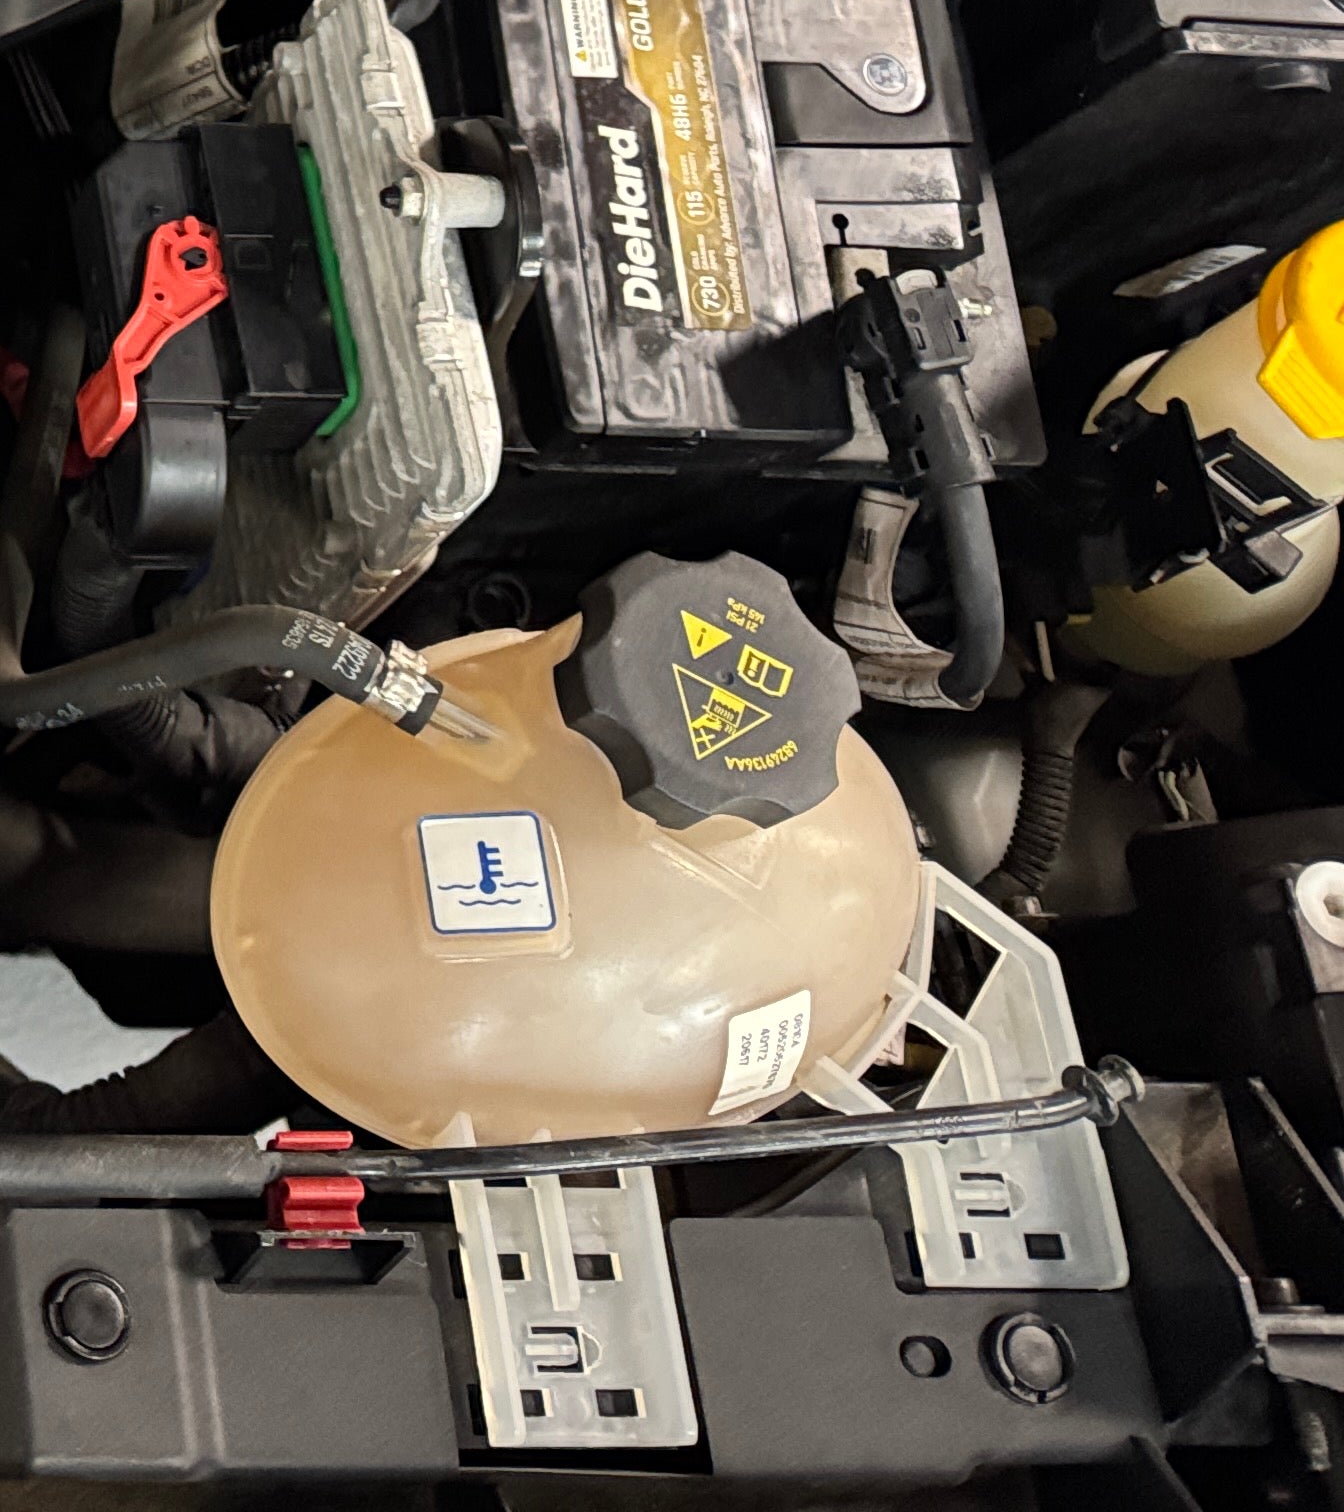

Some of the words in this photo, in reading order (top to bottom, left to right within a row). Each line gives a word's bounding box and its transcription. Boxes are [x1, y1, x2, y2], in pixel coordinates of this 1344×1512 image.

[668, 93, 692, 142] 48H6
[684, 190, 706, 218] 115
[713, 173, 725, 196] Auto
[597, 125, 663, 313] DieHard
[717, 197, 733, 240] Advance
[699, 275, 721, 310] 730
[725, 258, 745, 314] Distributed
[726, 609, 745, 627] PSI
